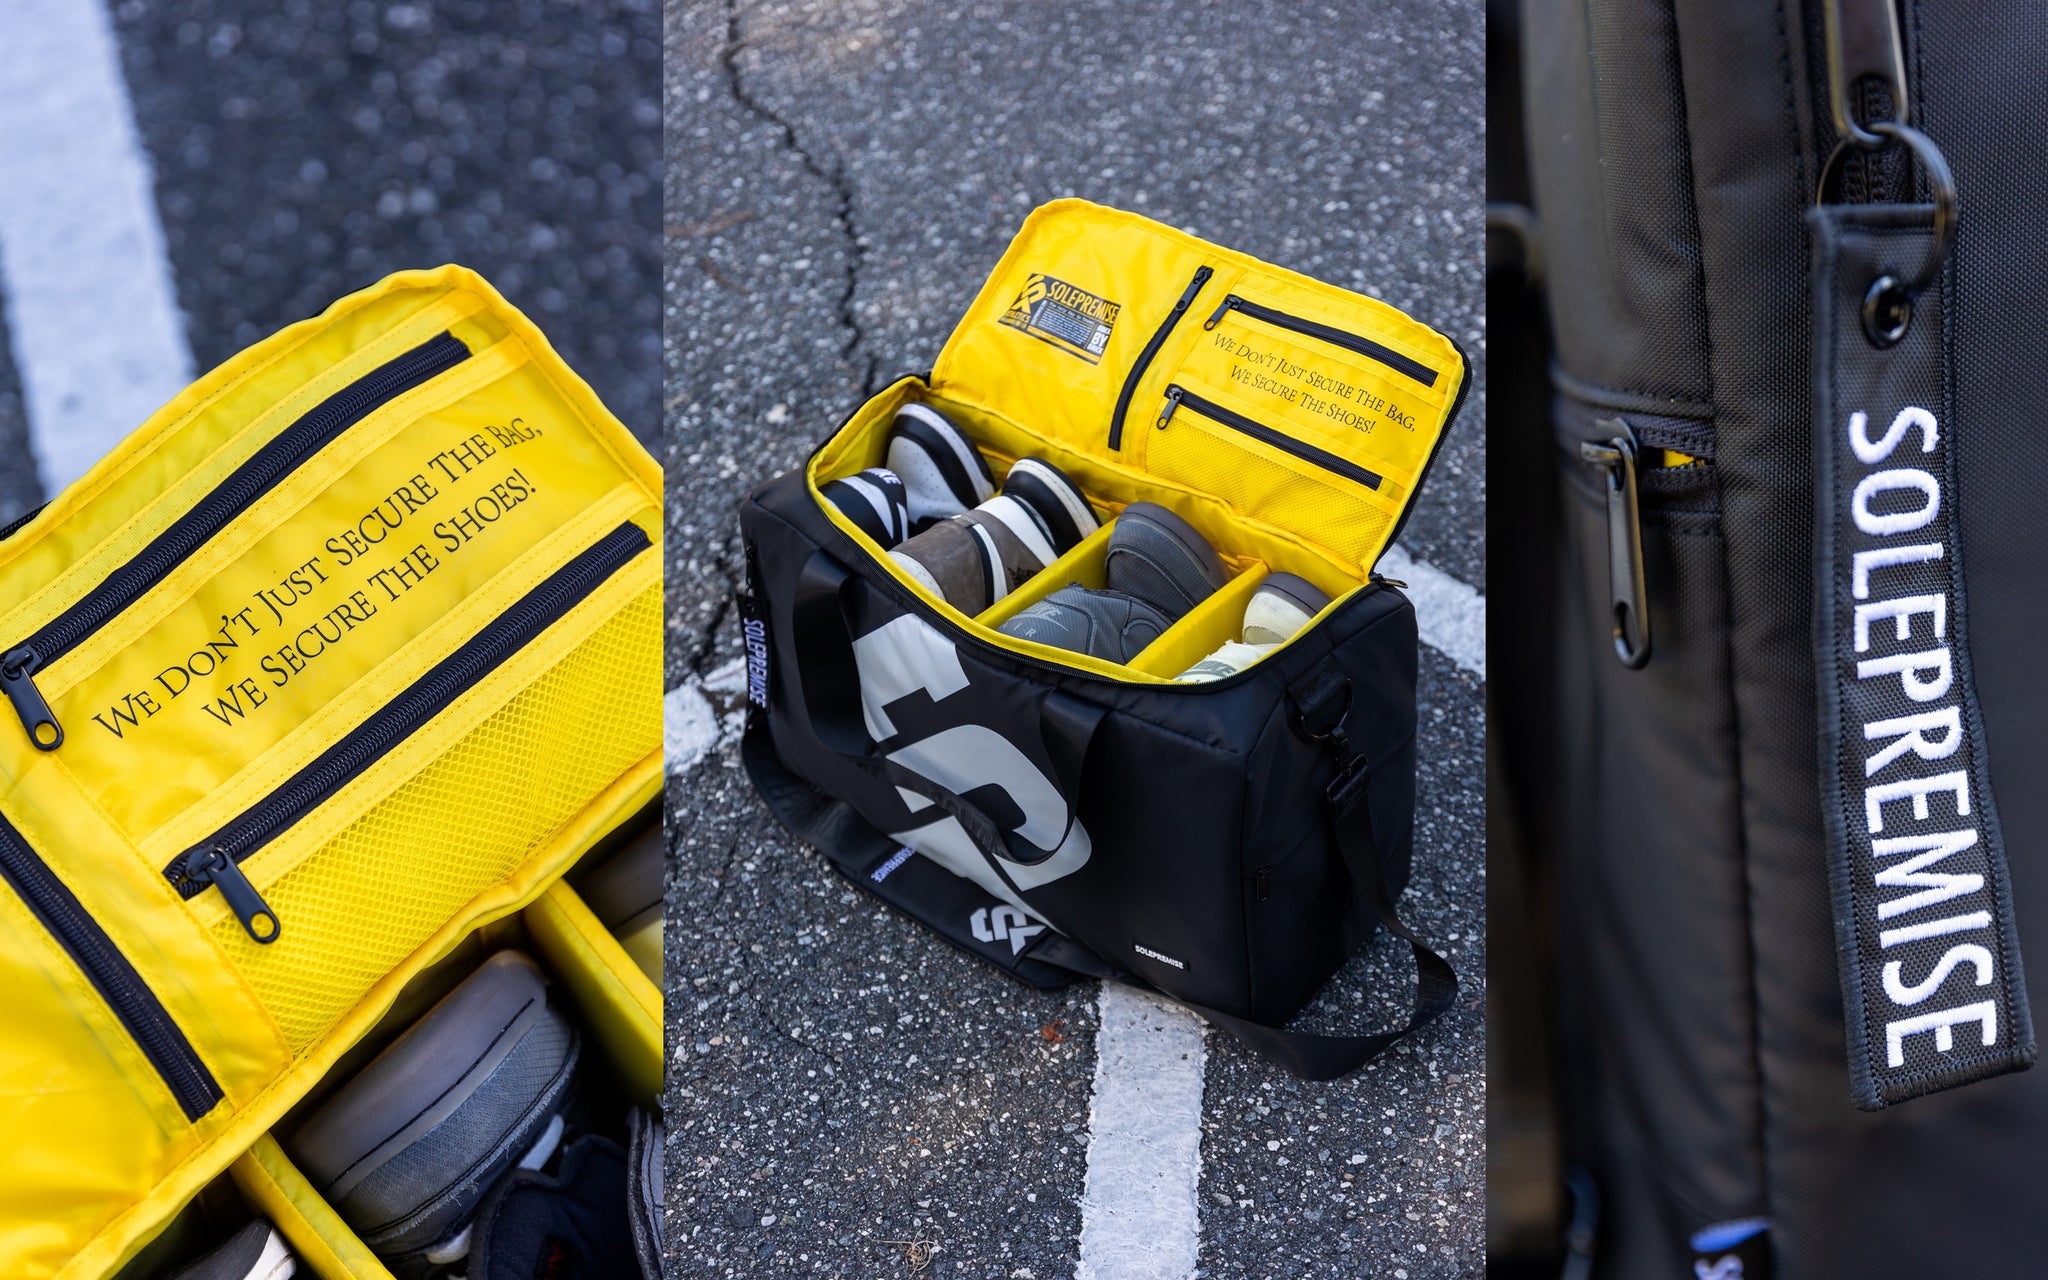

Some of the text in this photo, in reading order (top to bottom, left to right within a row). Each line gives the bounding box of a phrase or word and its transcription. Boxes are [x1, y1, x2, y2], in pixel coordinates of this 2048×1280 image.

[1046, 281, 1119, 324] SOLEPREMISE
[1214, 333, 1416, 432] WE DON'T JUST SECURE THE BAG,
[1230, 365, 1376, 434] WE SECURE THE SHOES!
[91, 417, 543, 739] WE DON'T JUST SECURE THE BAG,
[201, 467, 537, 727] WE SECURE THE SHOES!
[743, 617, 767, 709] SOLEPREMISE
[1848, 406, 1997, 1069] SOLEPREMISE
[1134, 944, 1184, 970] SOLEPREMISE
